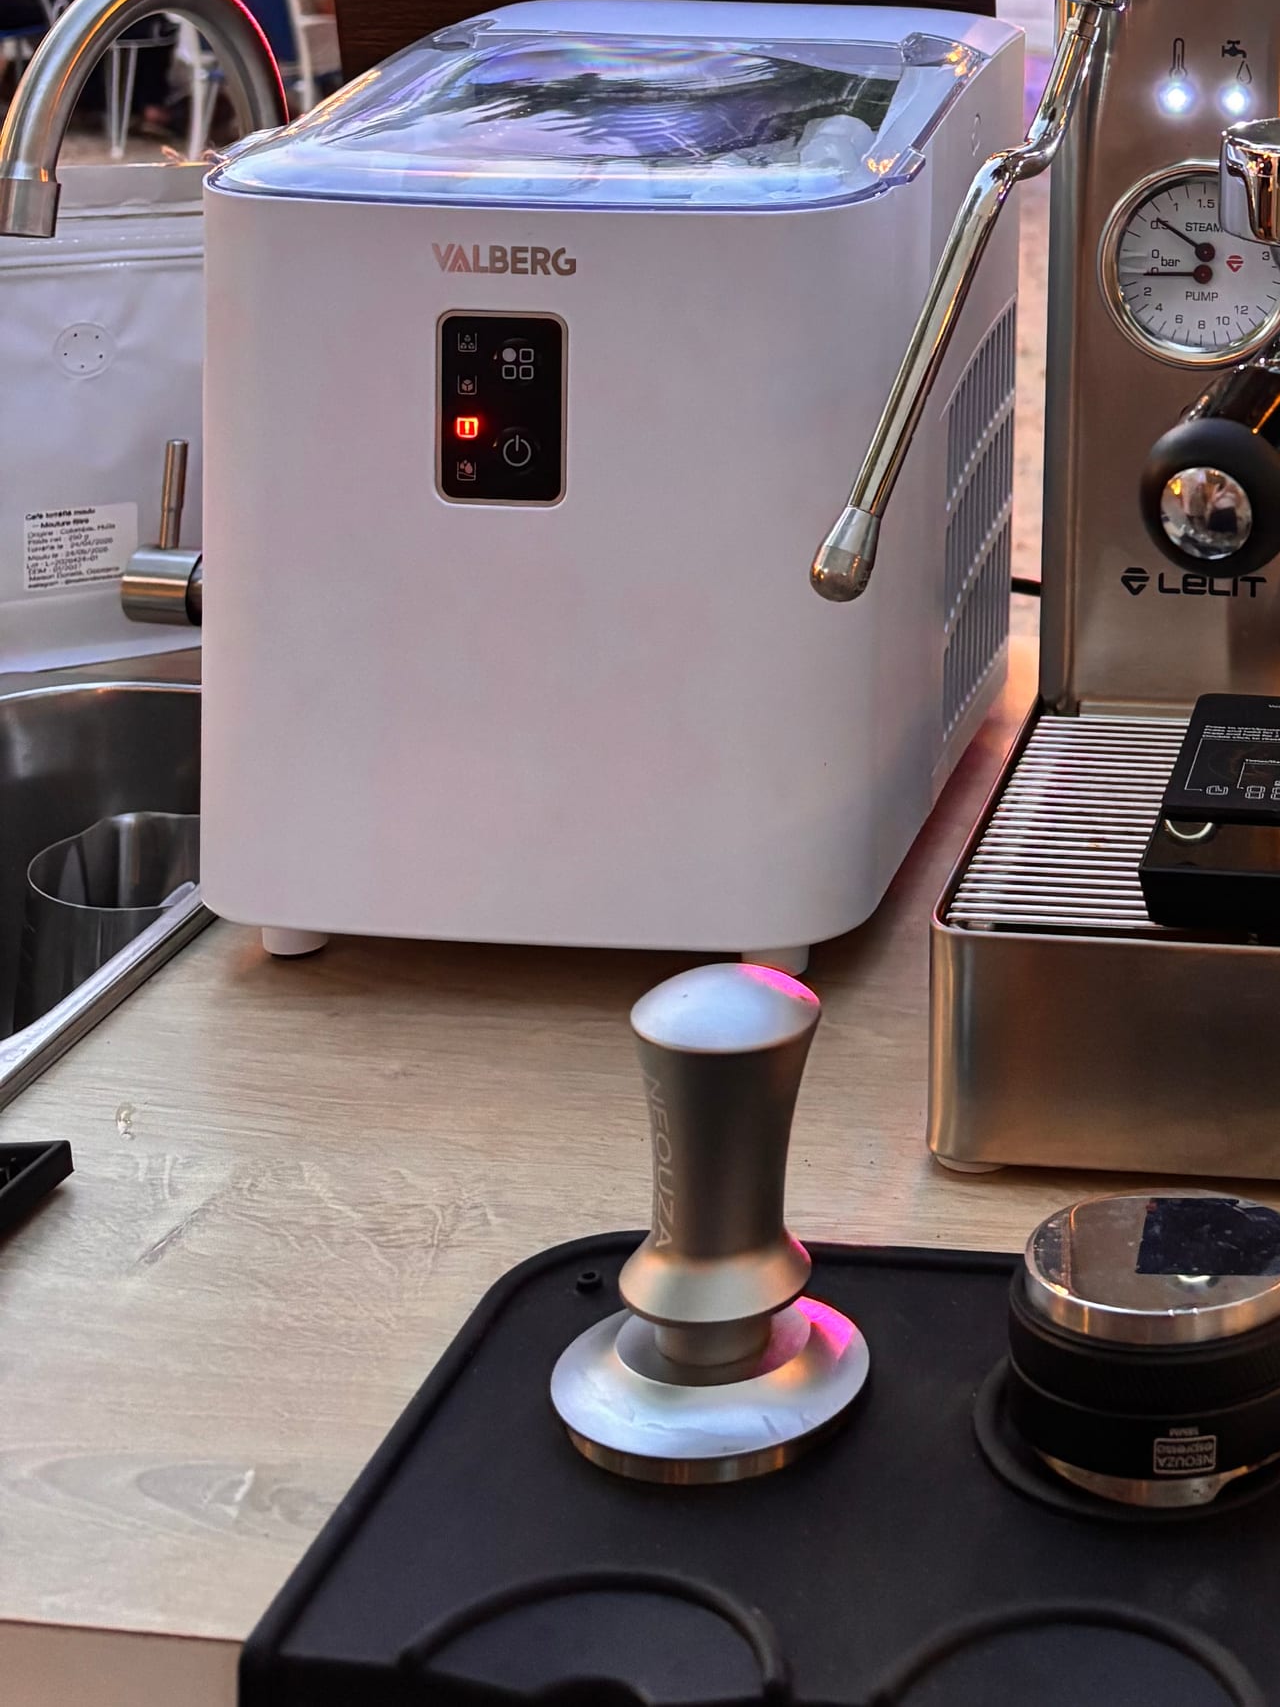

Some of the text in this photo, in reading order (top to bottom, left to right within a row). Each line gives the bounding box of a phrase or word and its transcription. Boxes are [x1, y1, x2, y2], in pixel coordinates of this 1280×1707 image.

[1197, 199, 1214, 208] 1.5
[1185, 222, 1224, 232] STEAM
[1152, 249, 1159, 258] 0
[432, 243, 576, 276] VALBERG
[1161, 256, 1180, 267] bar
[1144, 288, 1152, 296] 2
[1185, 291, 1219, 302] PUMP
[1155, 303, 1162, 311] 4
[1234, 306, 1248, 314] 12
[1176, 315, 1183, 324] 6
[1216, 316, 1230, 325] 10
[1198, 321, 1205, 329] 8
[645, 1075, 674, 1248] NEOUZA
